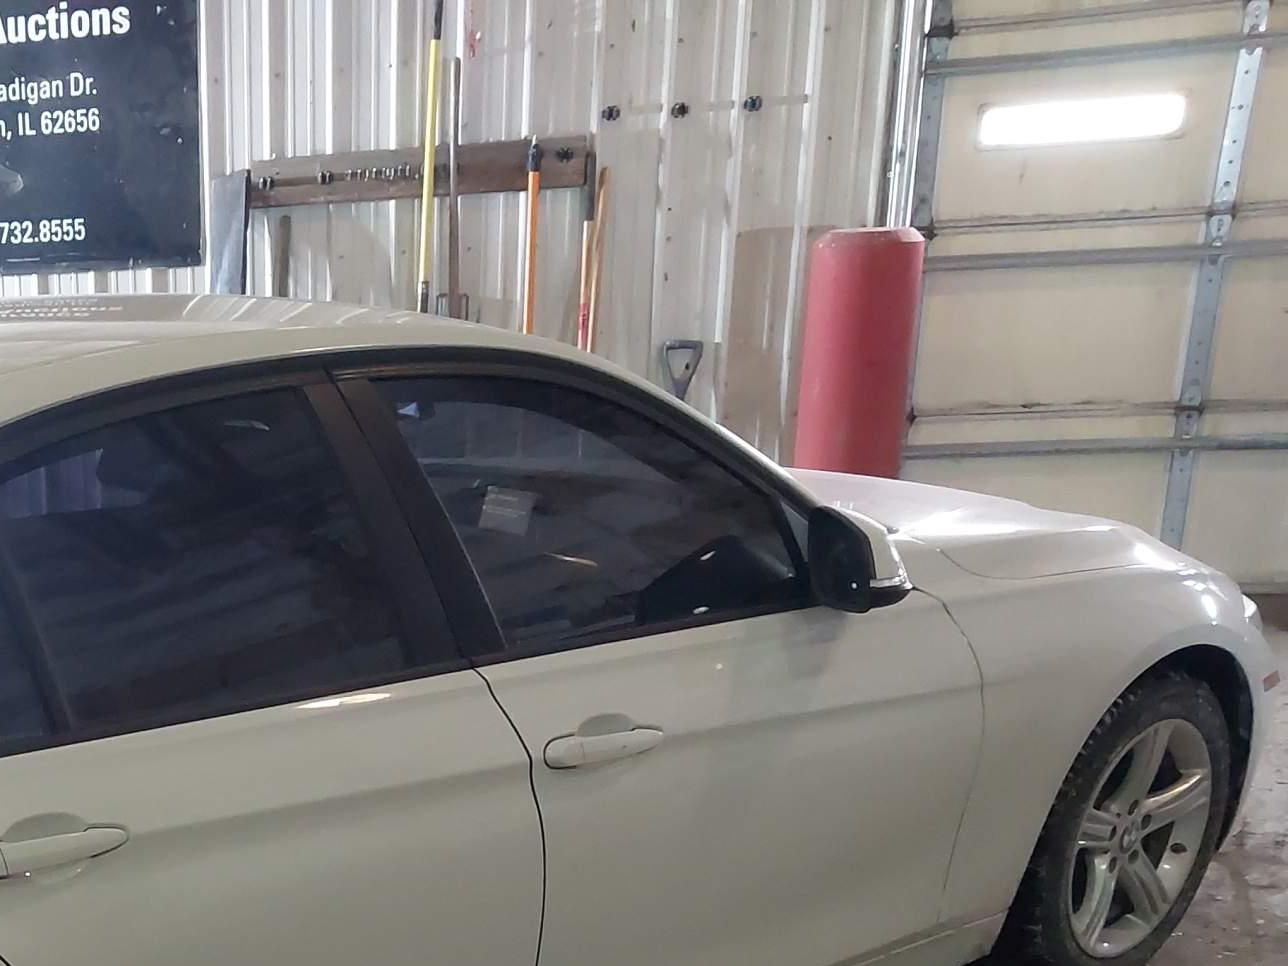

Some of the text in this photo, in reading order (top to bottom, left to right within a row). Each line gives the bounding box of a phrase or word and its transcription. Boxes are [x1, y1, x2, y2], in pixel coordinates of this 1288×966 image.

[69, 72, 97, 97] Dr.
[18, 112, 36, 136] IL
[40, 108, 100, 134] 62656
